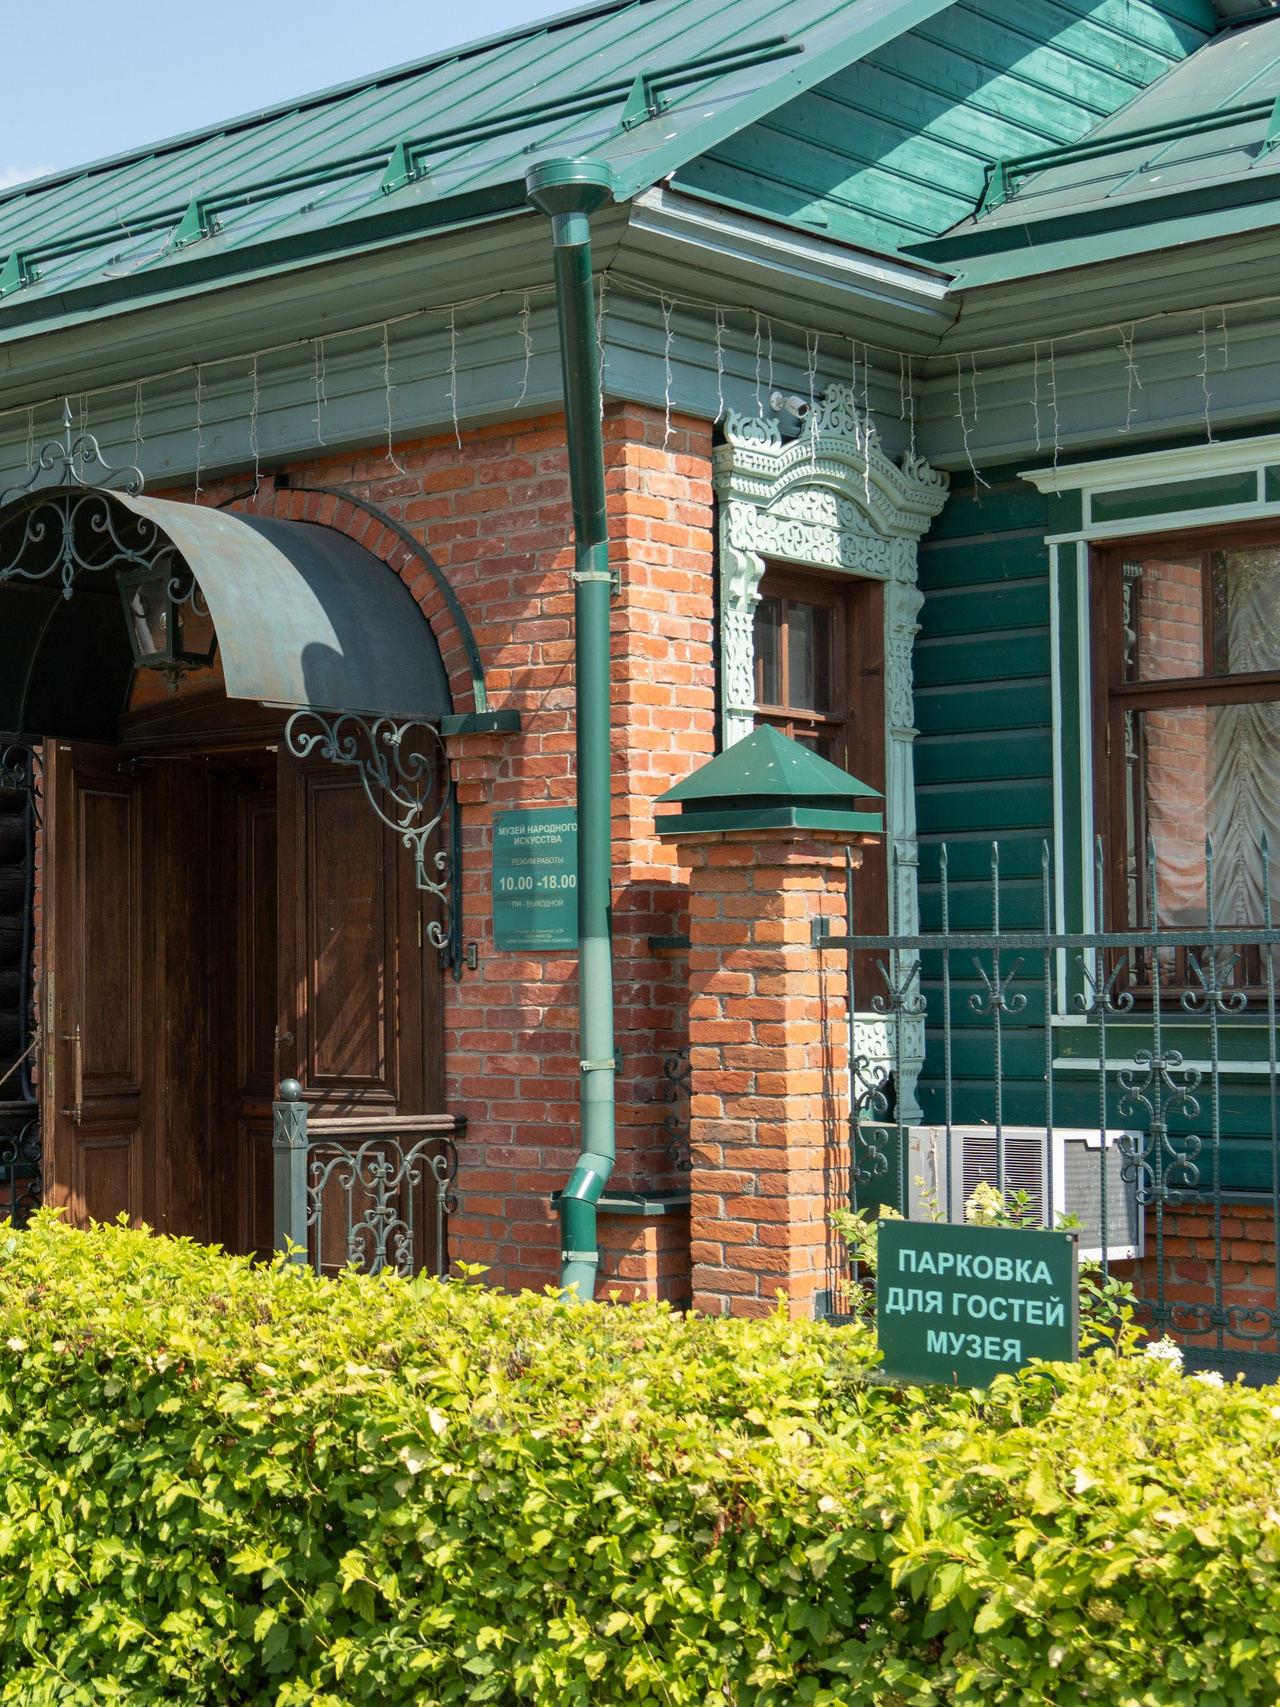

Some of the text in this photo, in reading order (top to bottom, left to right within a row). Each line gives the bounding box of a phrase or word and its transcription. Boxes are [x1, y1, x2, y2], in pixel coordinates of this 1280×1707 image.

[499, 823, 577, 836] МУЗЕЙ НАРОДНОГО
[514, 835, 562, 845] ИСКУССТВА
[511, 856, 564, 866] РЕЖИМ РАБОТЫ
[499, 875, 533, 891] 10.00
[511, 900, 522, 908] ПН
[526, 899, 564, 908] ВЫХОДНОЙ
[898, 1249, 1054, 1286] ПАРКОВКА
[885, 1287, 1065, 1327] ДЛЯ ГОСТЕЙ
[926, 1329, 1022, 1363] МУЗЕЯ
